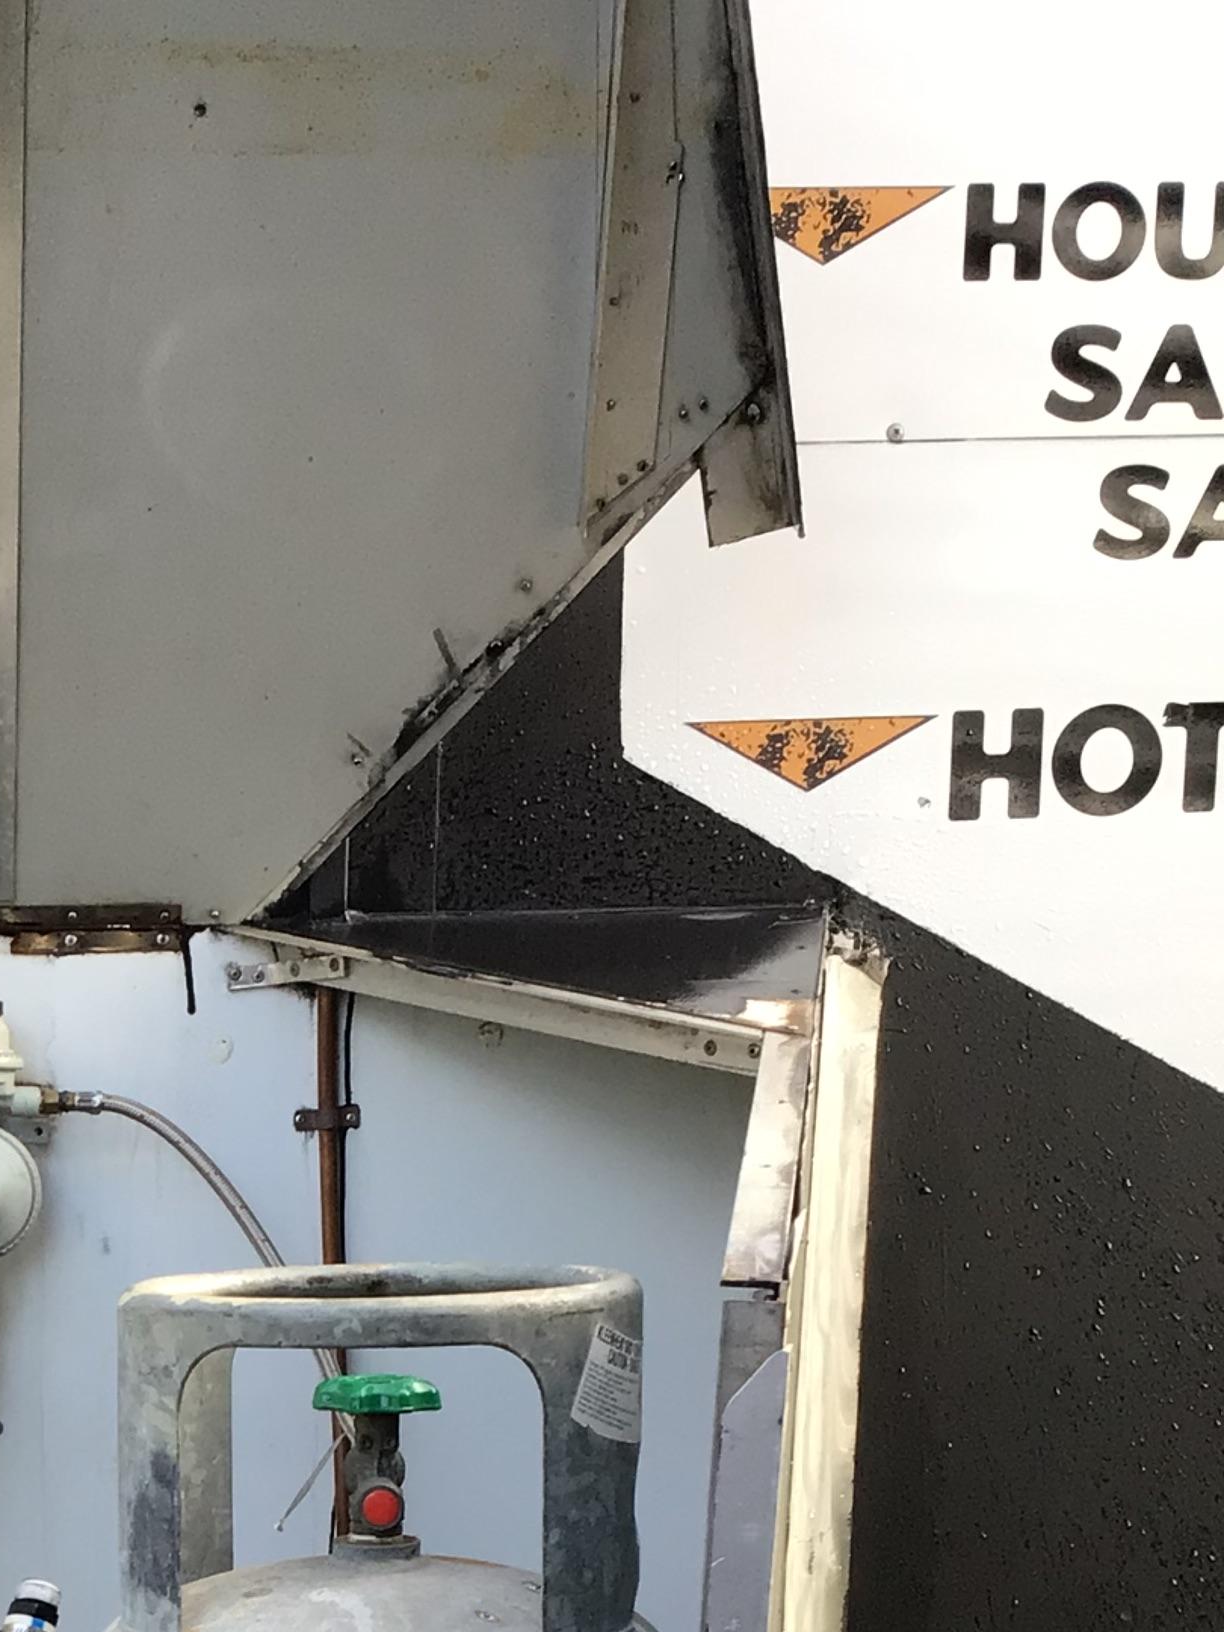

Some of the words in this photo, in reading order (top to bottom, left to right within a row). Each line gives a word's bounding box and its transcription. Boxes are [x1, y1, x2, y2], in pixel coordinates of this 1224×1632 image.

[963, 181, 1224, 281] HOU
[1044, 324, 1224, 422] SA
[948, 702, 1224, 822] HOT
